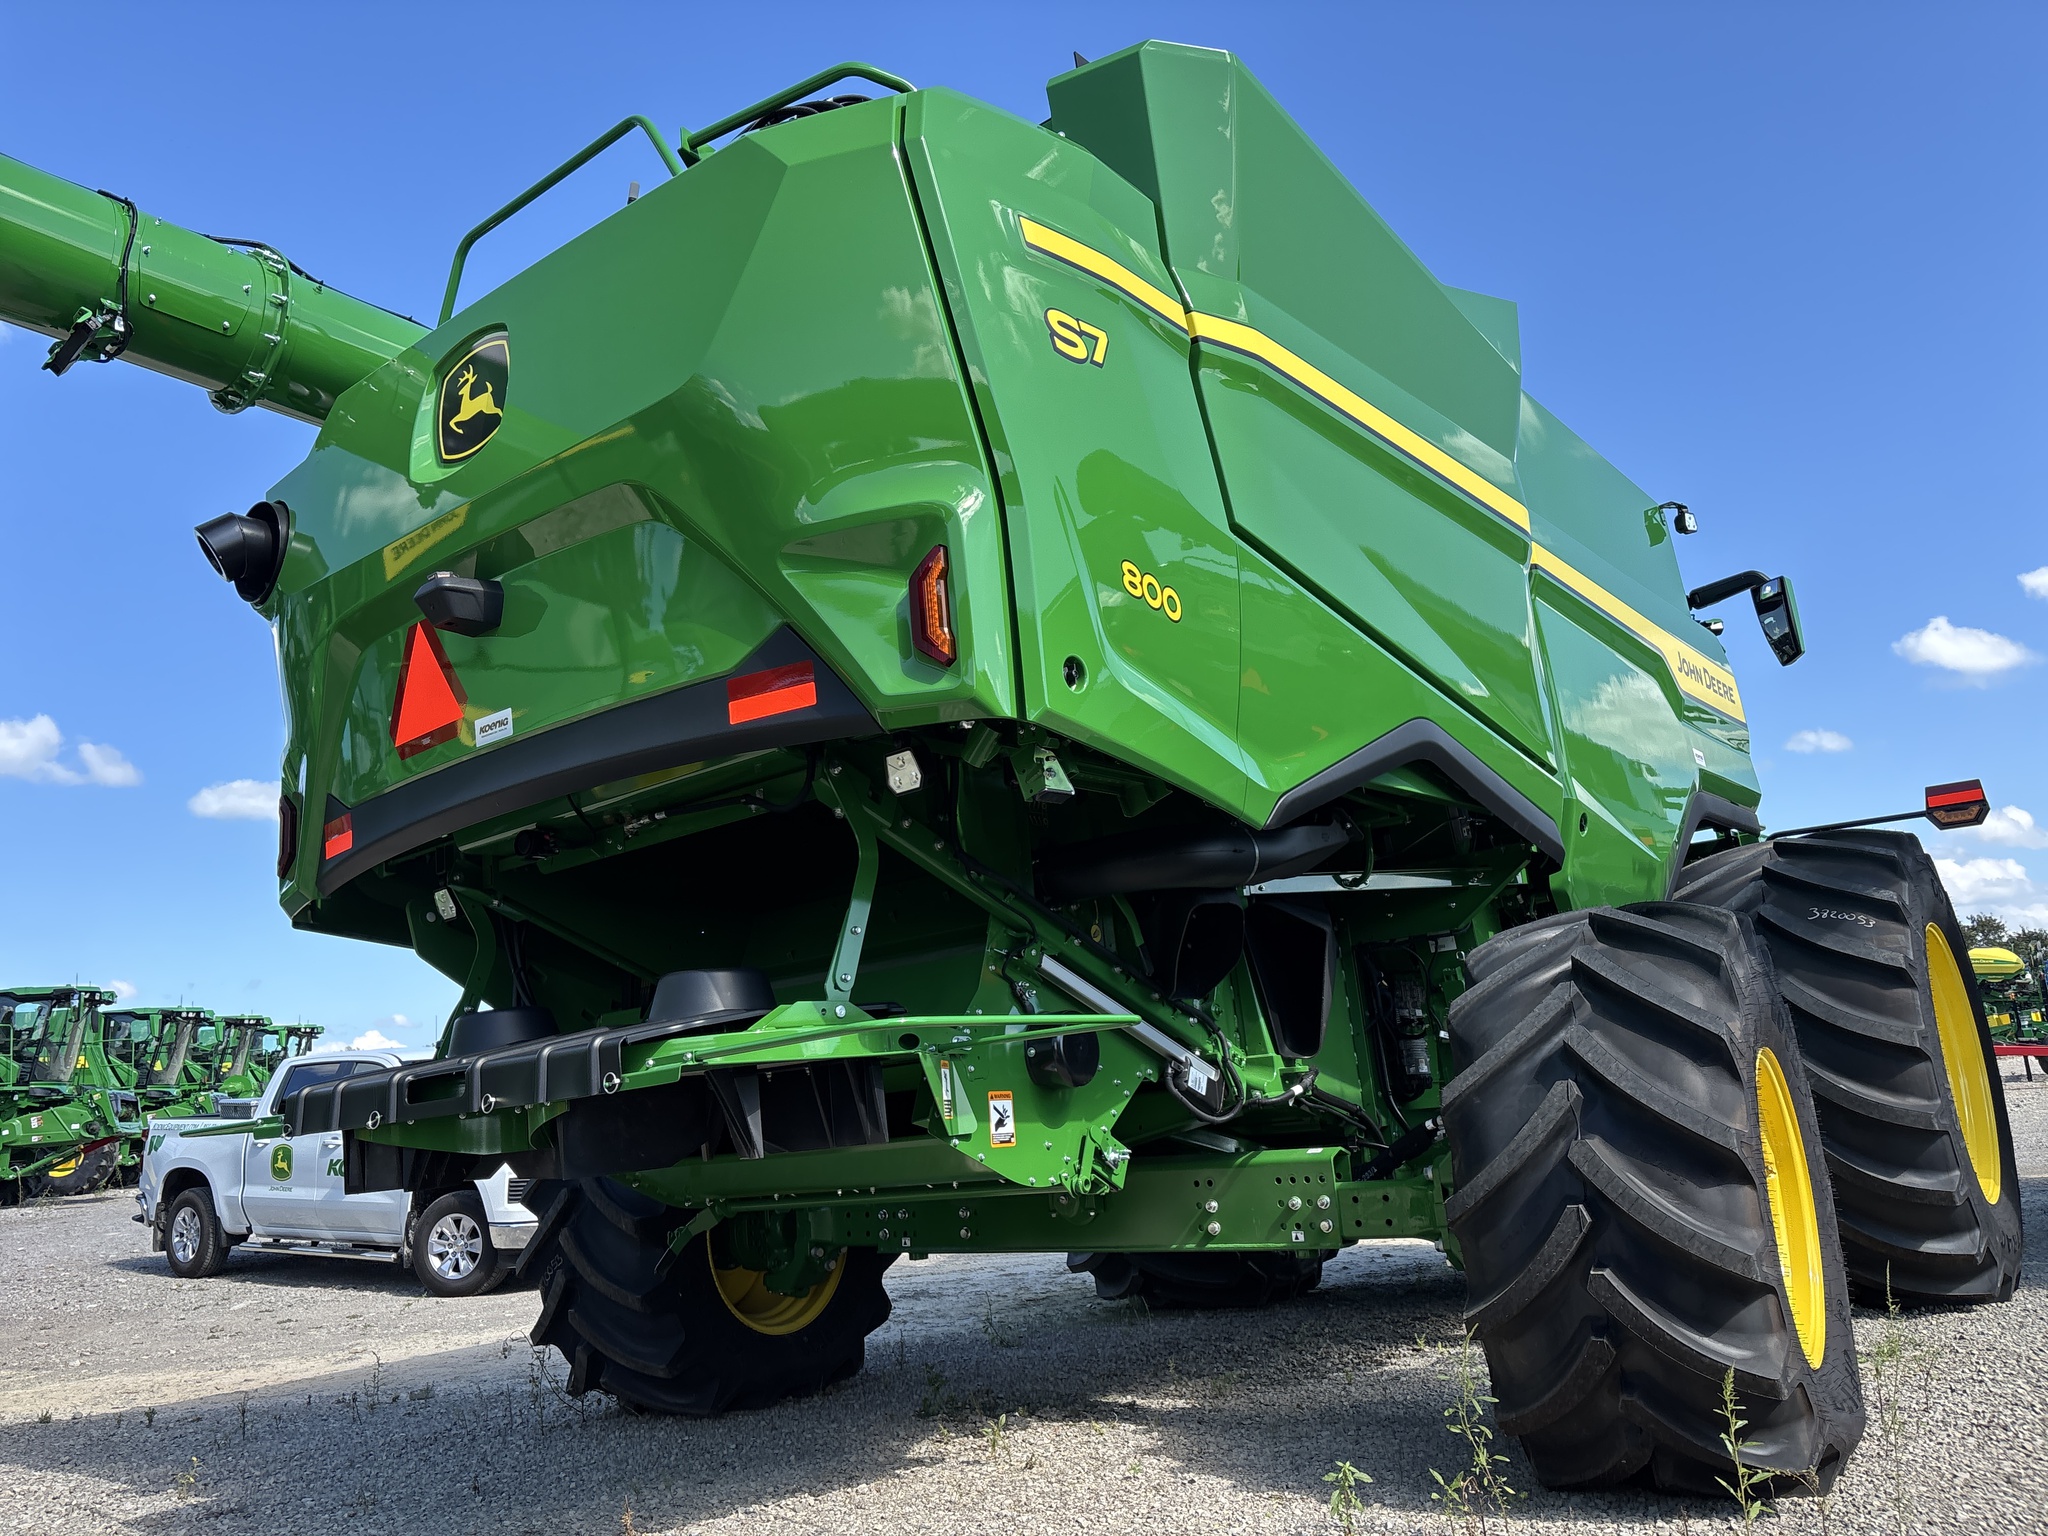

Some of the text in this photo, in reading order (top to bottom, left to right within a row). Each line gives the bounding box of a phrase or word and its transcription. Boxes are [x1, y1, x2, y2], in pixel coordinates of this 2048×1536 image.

[1044, 311, 1109, 368] S7
[1121, 559, 1182, 623] 800
[1677, 651, 1735, 705] JOHN DEERE
[1807, 907, 1876, 928] 3820053
